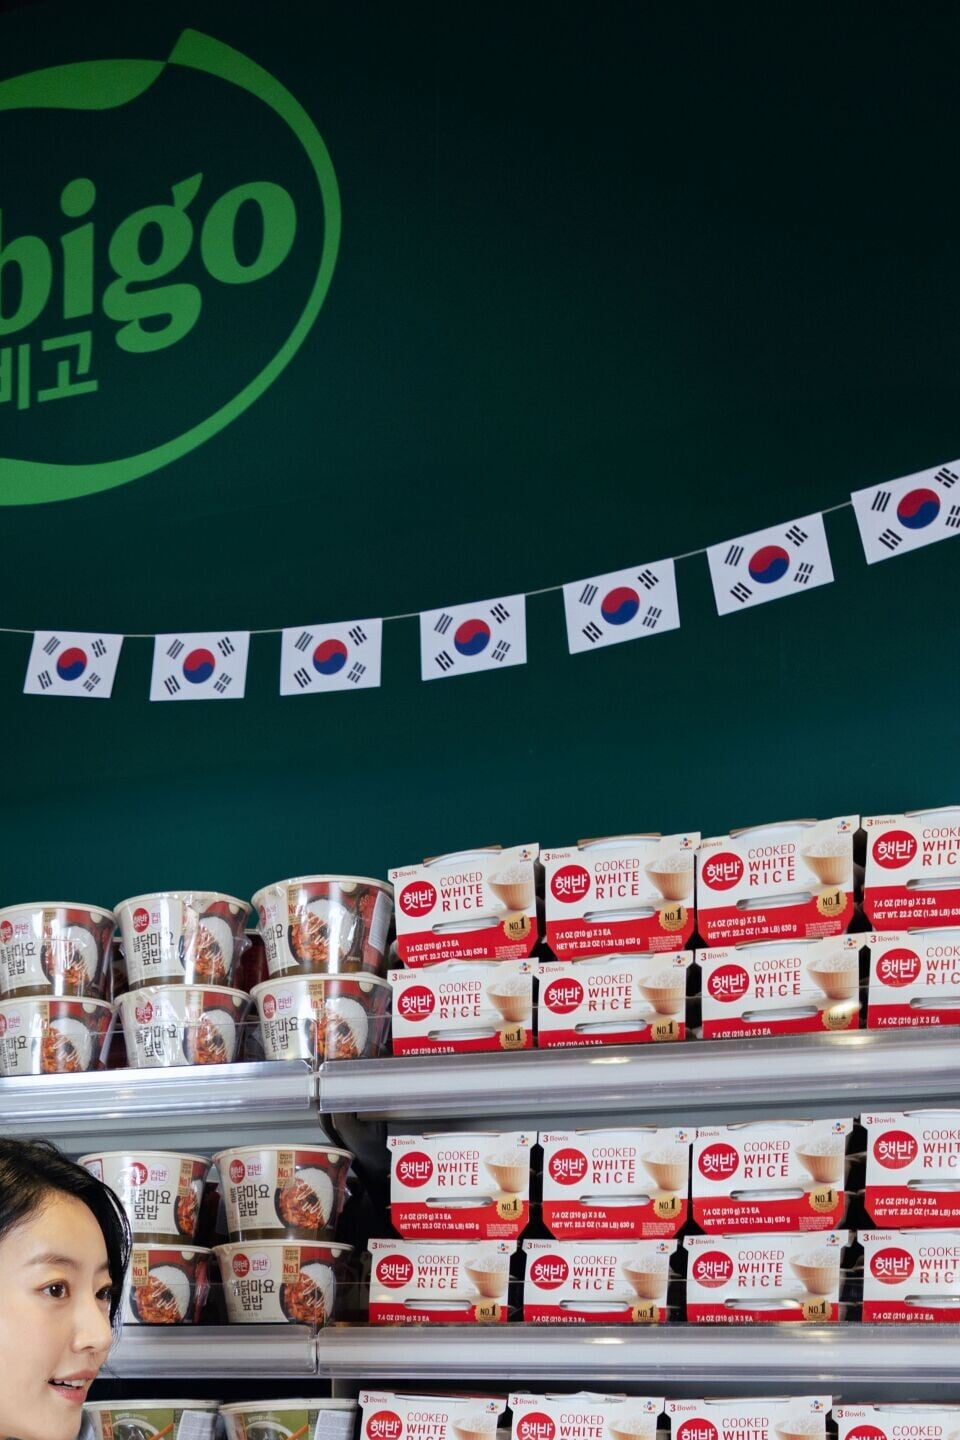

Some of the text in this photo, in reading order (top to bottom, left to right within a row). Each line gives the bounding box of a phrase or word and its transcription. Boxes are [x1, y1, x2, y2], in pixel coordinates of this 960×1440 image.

[748, 844, 796, 860] COOKED
[877, 843, 912, 860] 햇반
[594, 859, 640, 872] COOKED
[748, 856, 795, 872] WHITE
[595, 872, 639, 885] WHITE
[706, 862, 740, 884] 햇반
[750, 870, 795, 886] RICE
[555, 874, 586, 896] 햇반
[596, 884, 639, 900] RICE
[717, 920, 726, 928] OZ
[438, 1150, 480, 1160] COOKED
[592, 1148, 636, 1158] COOKED
[400, 1161, 429, 1180] 햇반
[438, 1162, 478, 1174] WHITE
[553, 1158, 582, 1179] 햇반
[592, 1160, 636, 1170] WHITE
[438, 1174, 478, 1186] RICE
[593, 1172, 635, 1184] RICE
[132, 1266, 148, 1276] No.1
[284, 1264, 298, 1274] No.1
[670, 1404, 676, 1412] 3
[722, 1418, 768, 1428] COOKED
[723, 1430, 768, 1440] WHITE
